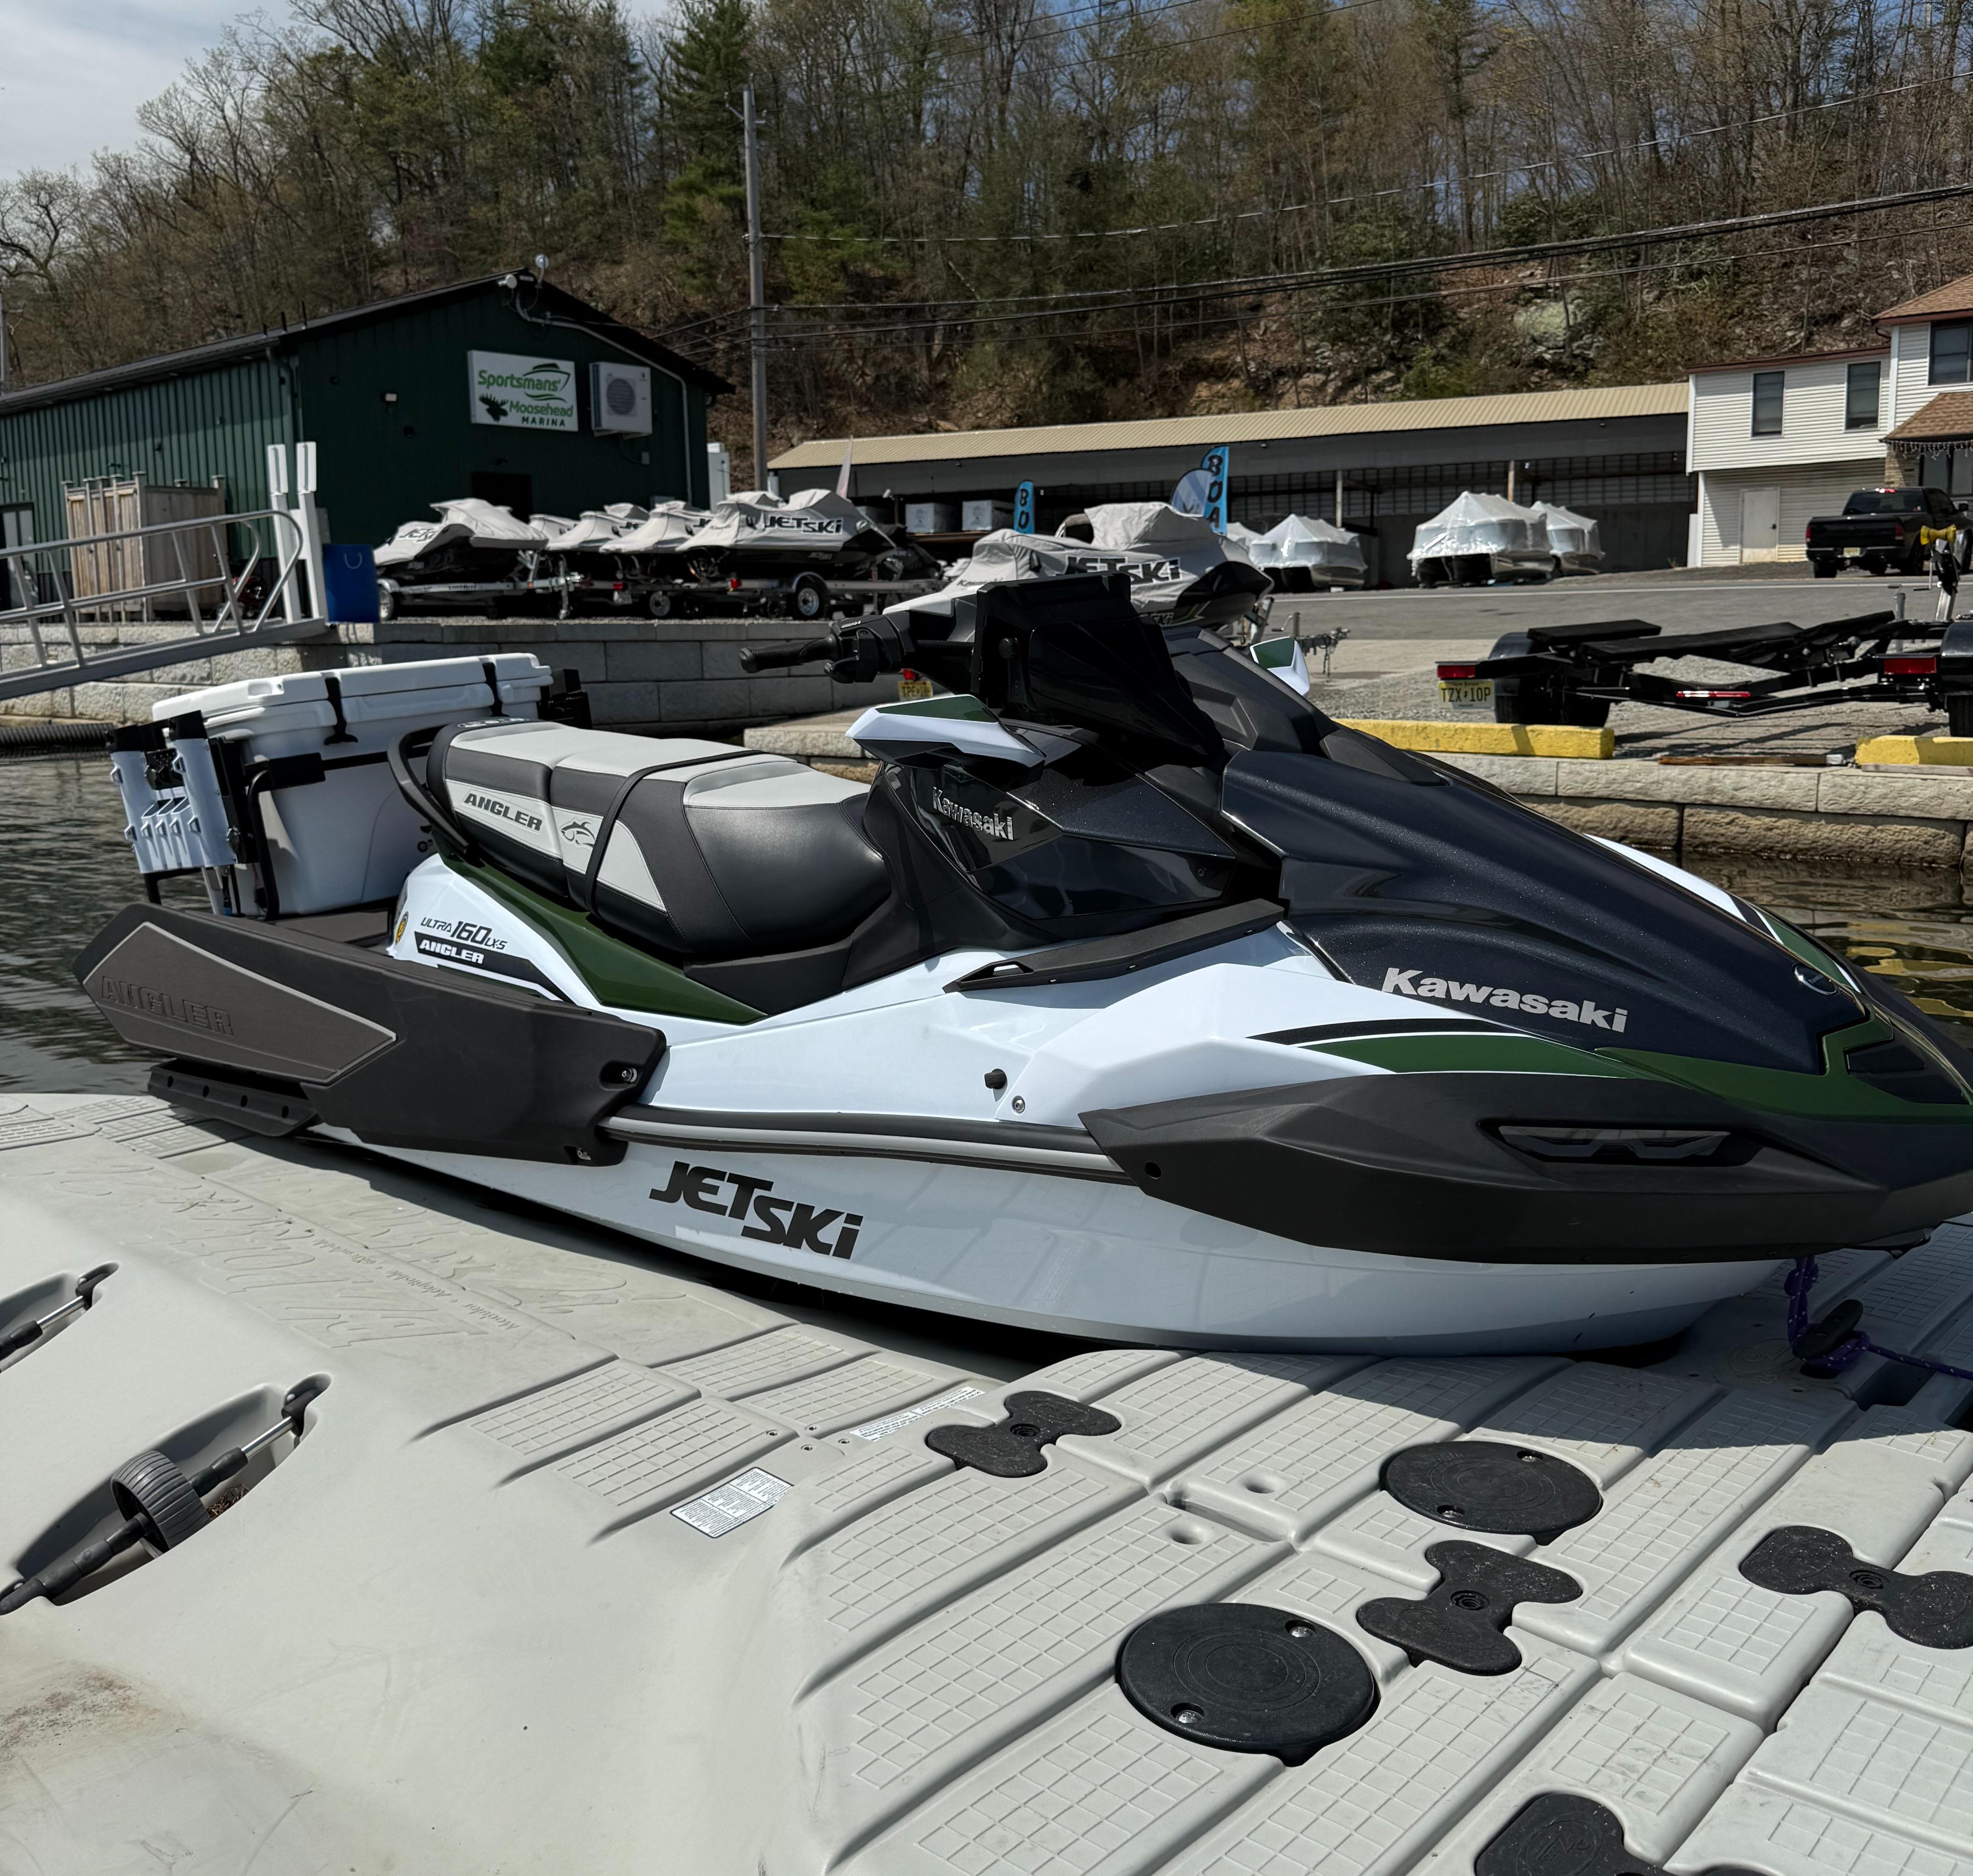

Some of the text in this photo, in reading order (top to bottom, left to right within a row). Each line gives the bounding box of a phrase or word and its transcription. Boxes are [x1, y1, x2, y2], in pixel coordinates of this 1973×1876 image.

[478, 370, 561, 392] Sportsmans'
[509, 400, 573, 417] Moosehead
[522, 416, 566, 427] MARINA
[1442, 687, 1461, 702] TZX
[464, 793, 543, 831] ANGLER
[933, 787, 1014, 841] Kawasaki
[420, 917, 452, 932] ULTRA
[451, 921, 492, 945] 160
[419, 939, 484, 964] ANGLER
[101, 976, 234, 1036] ANGLER
[1382, 967, 1628, 1033] Kawasaki
